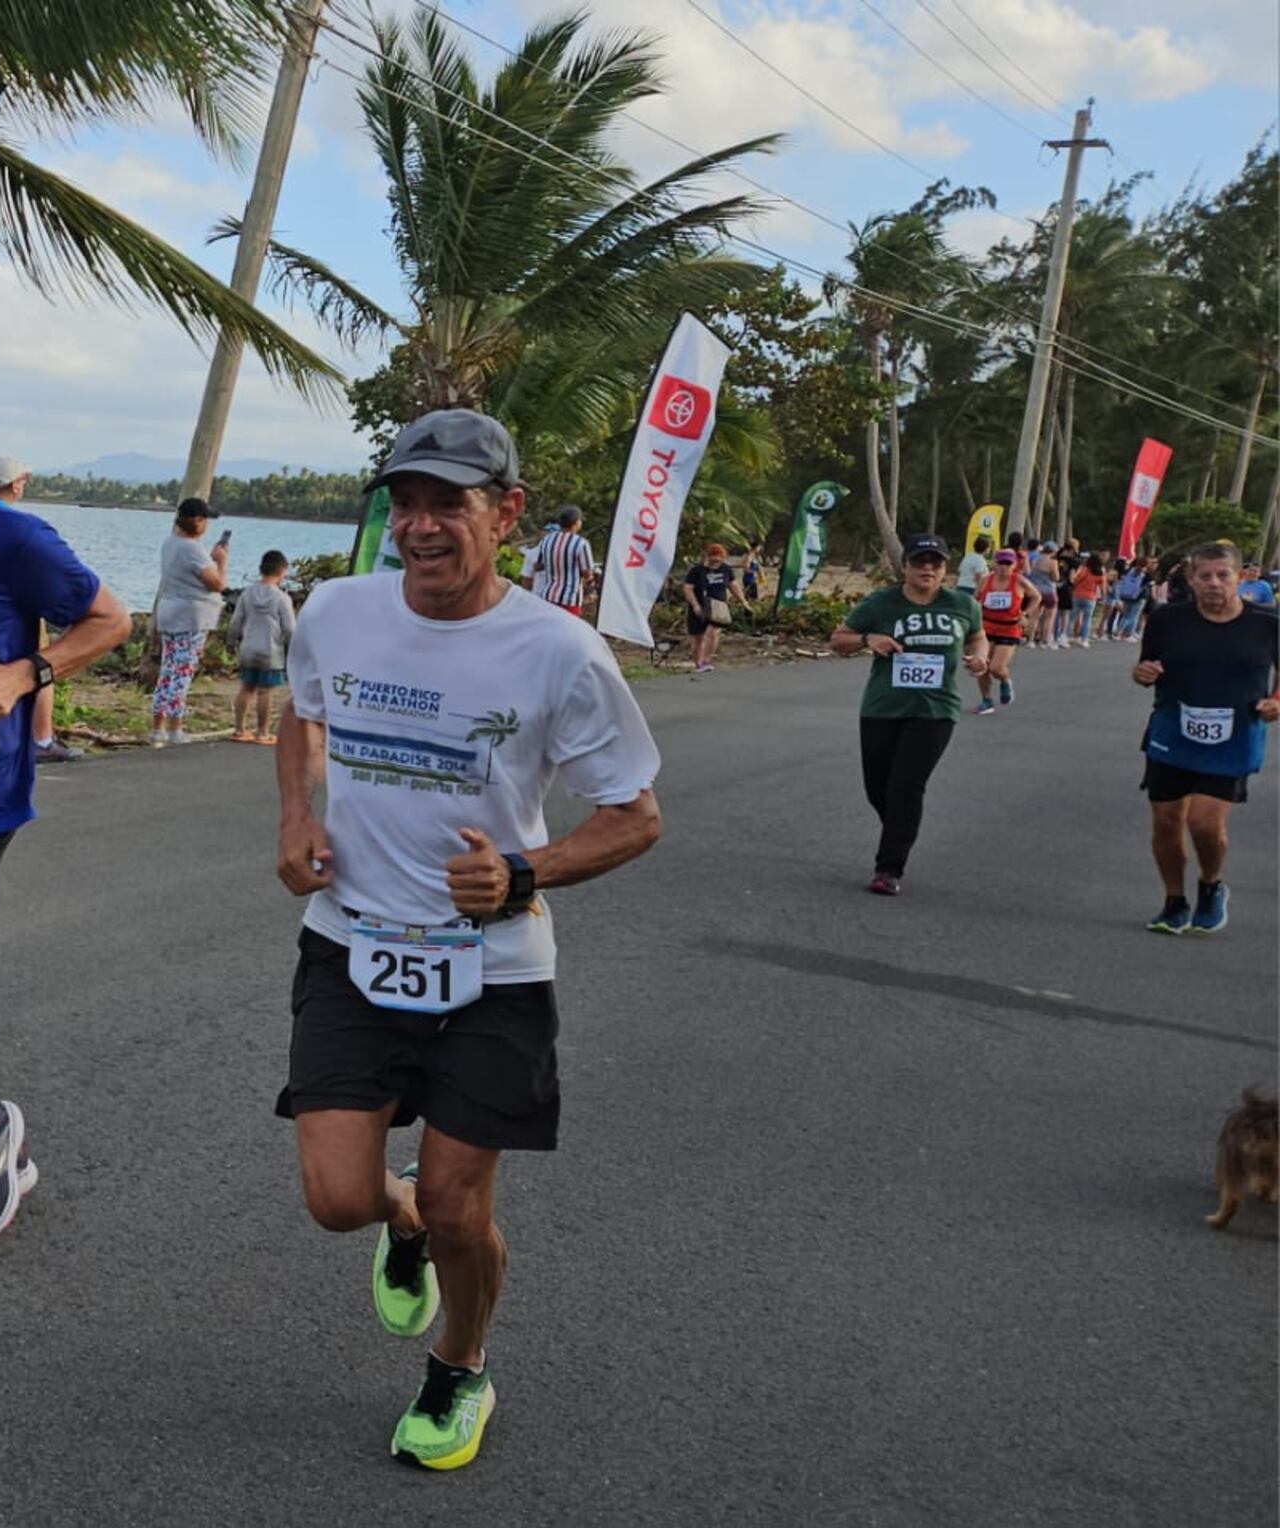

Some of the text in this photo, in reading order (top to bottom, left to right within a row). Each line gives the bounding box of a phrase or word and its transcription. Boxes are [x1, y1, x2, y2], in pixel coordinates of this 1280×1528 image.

[626, 450, 676, 568] TOYOTA
[899, 666, 935, 684] 682
[359, 691, 441, 713] MARATHON
[360, 680, 442, 702] PUERTO RICO
[387, 706, 440, 721] MARATHON
[1186, 720, 1223, 740] 683
[343, 743, 356, 757] IN
[359, 747, 432, 767] PARADISE
[436, 757, 469, 772] 2014
[370, 949, 451, 1003] 251
